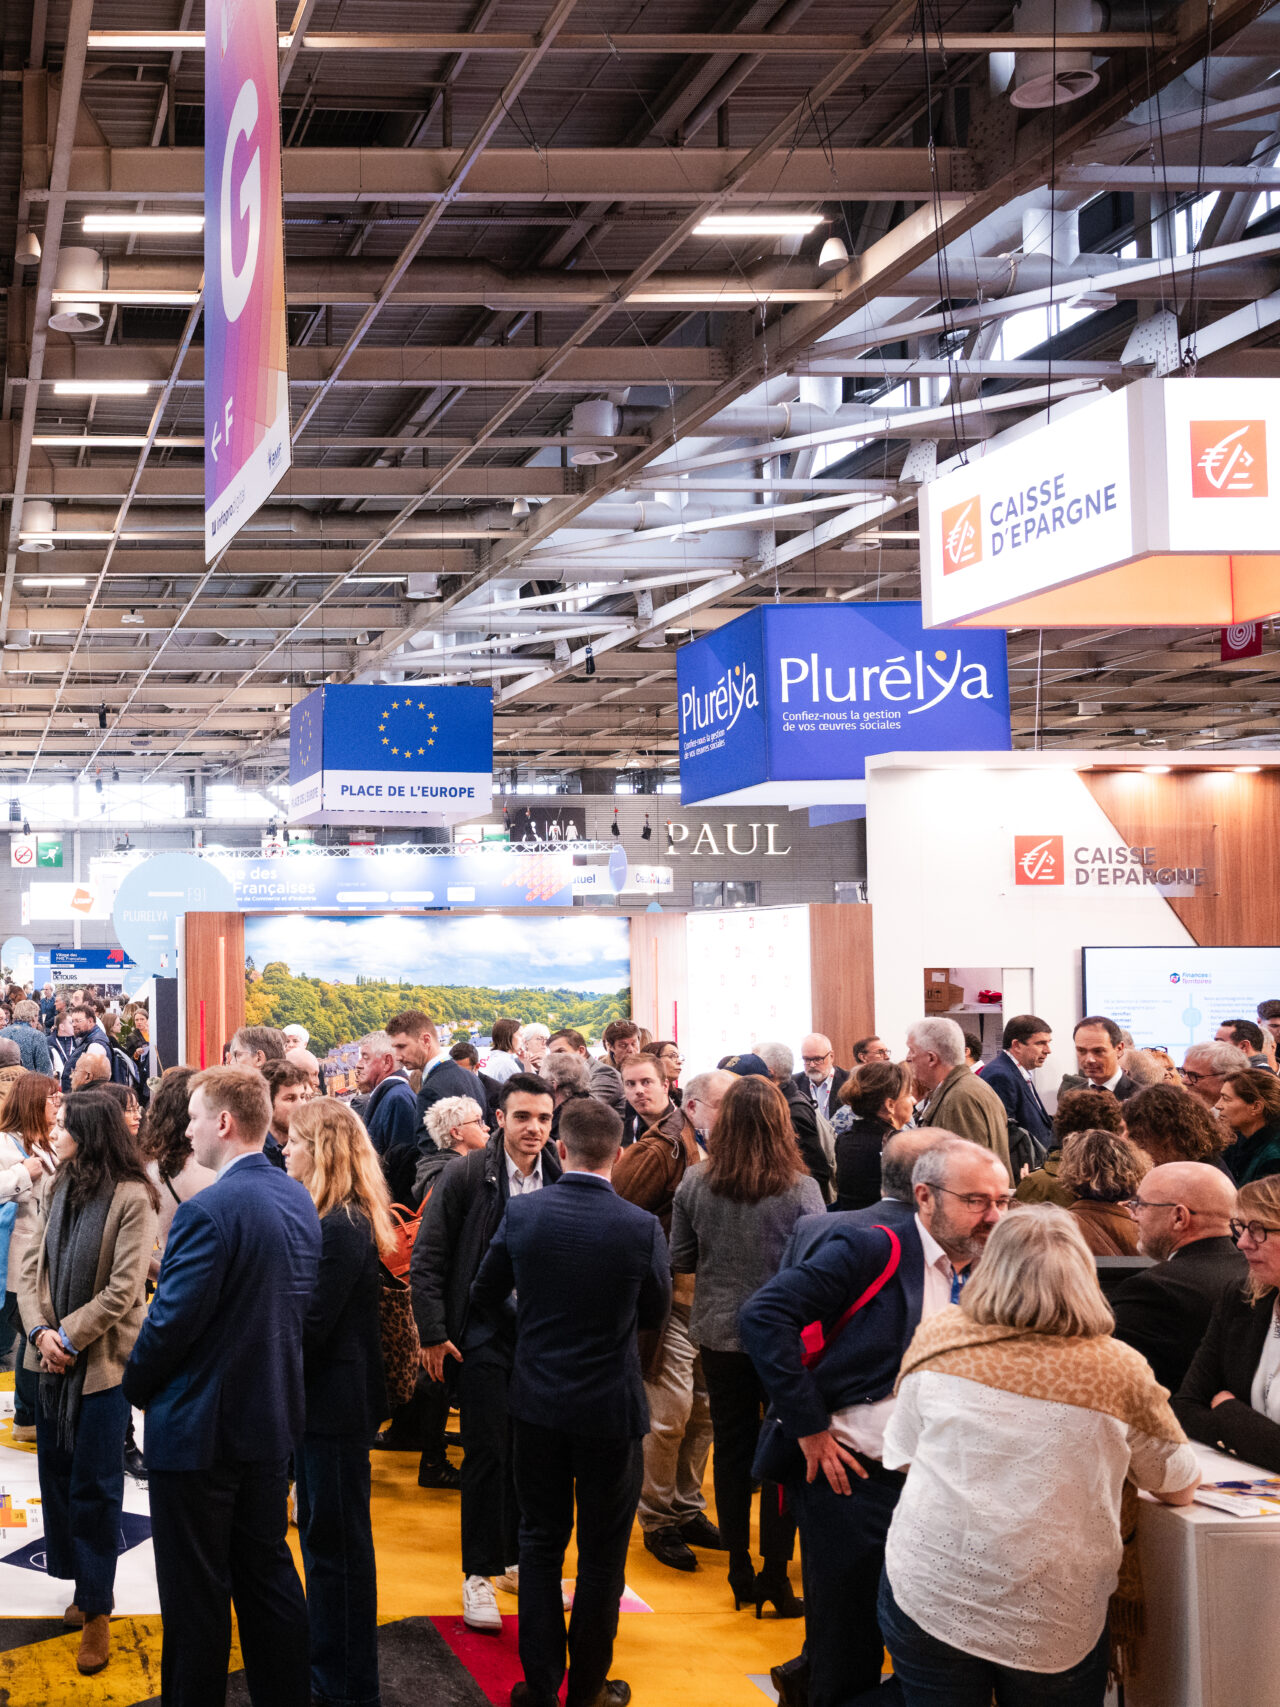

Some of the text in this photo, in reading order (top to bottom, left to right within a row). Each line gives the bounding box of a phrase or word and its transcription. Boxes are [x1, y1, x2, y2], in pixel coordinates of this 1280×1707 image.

[221, 79, 261, 323] G
[224, 396, 234, 447] F
[990, 472, 1066, 527] CAISSE
[991, 482, 1117, 557] D'EPARGNE
[780, 649, 994, 715] Plurélya
[681, 660, 760, 735] Plurélya
[782, 709, 901, 723] Confiez-nous la gestion
[782, 720, 901, 732] de vos œuvres sociales
[341, 785, 475, 798] PLACE DE L'EUROPE
[664, 823, 791, 855] PAUL
[1074, 847, 1157, 865] CAISSE
[250, 867, 277, 880] des
[572, 874, 596, 884] tuel
[1075, 867, 1209, 886] D'EPARGNE
[232, 881, 316, 896] Françaises
